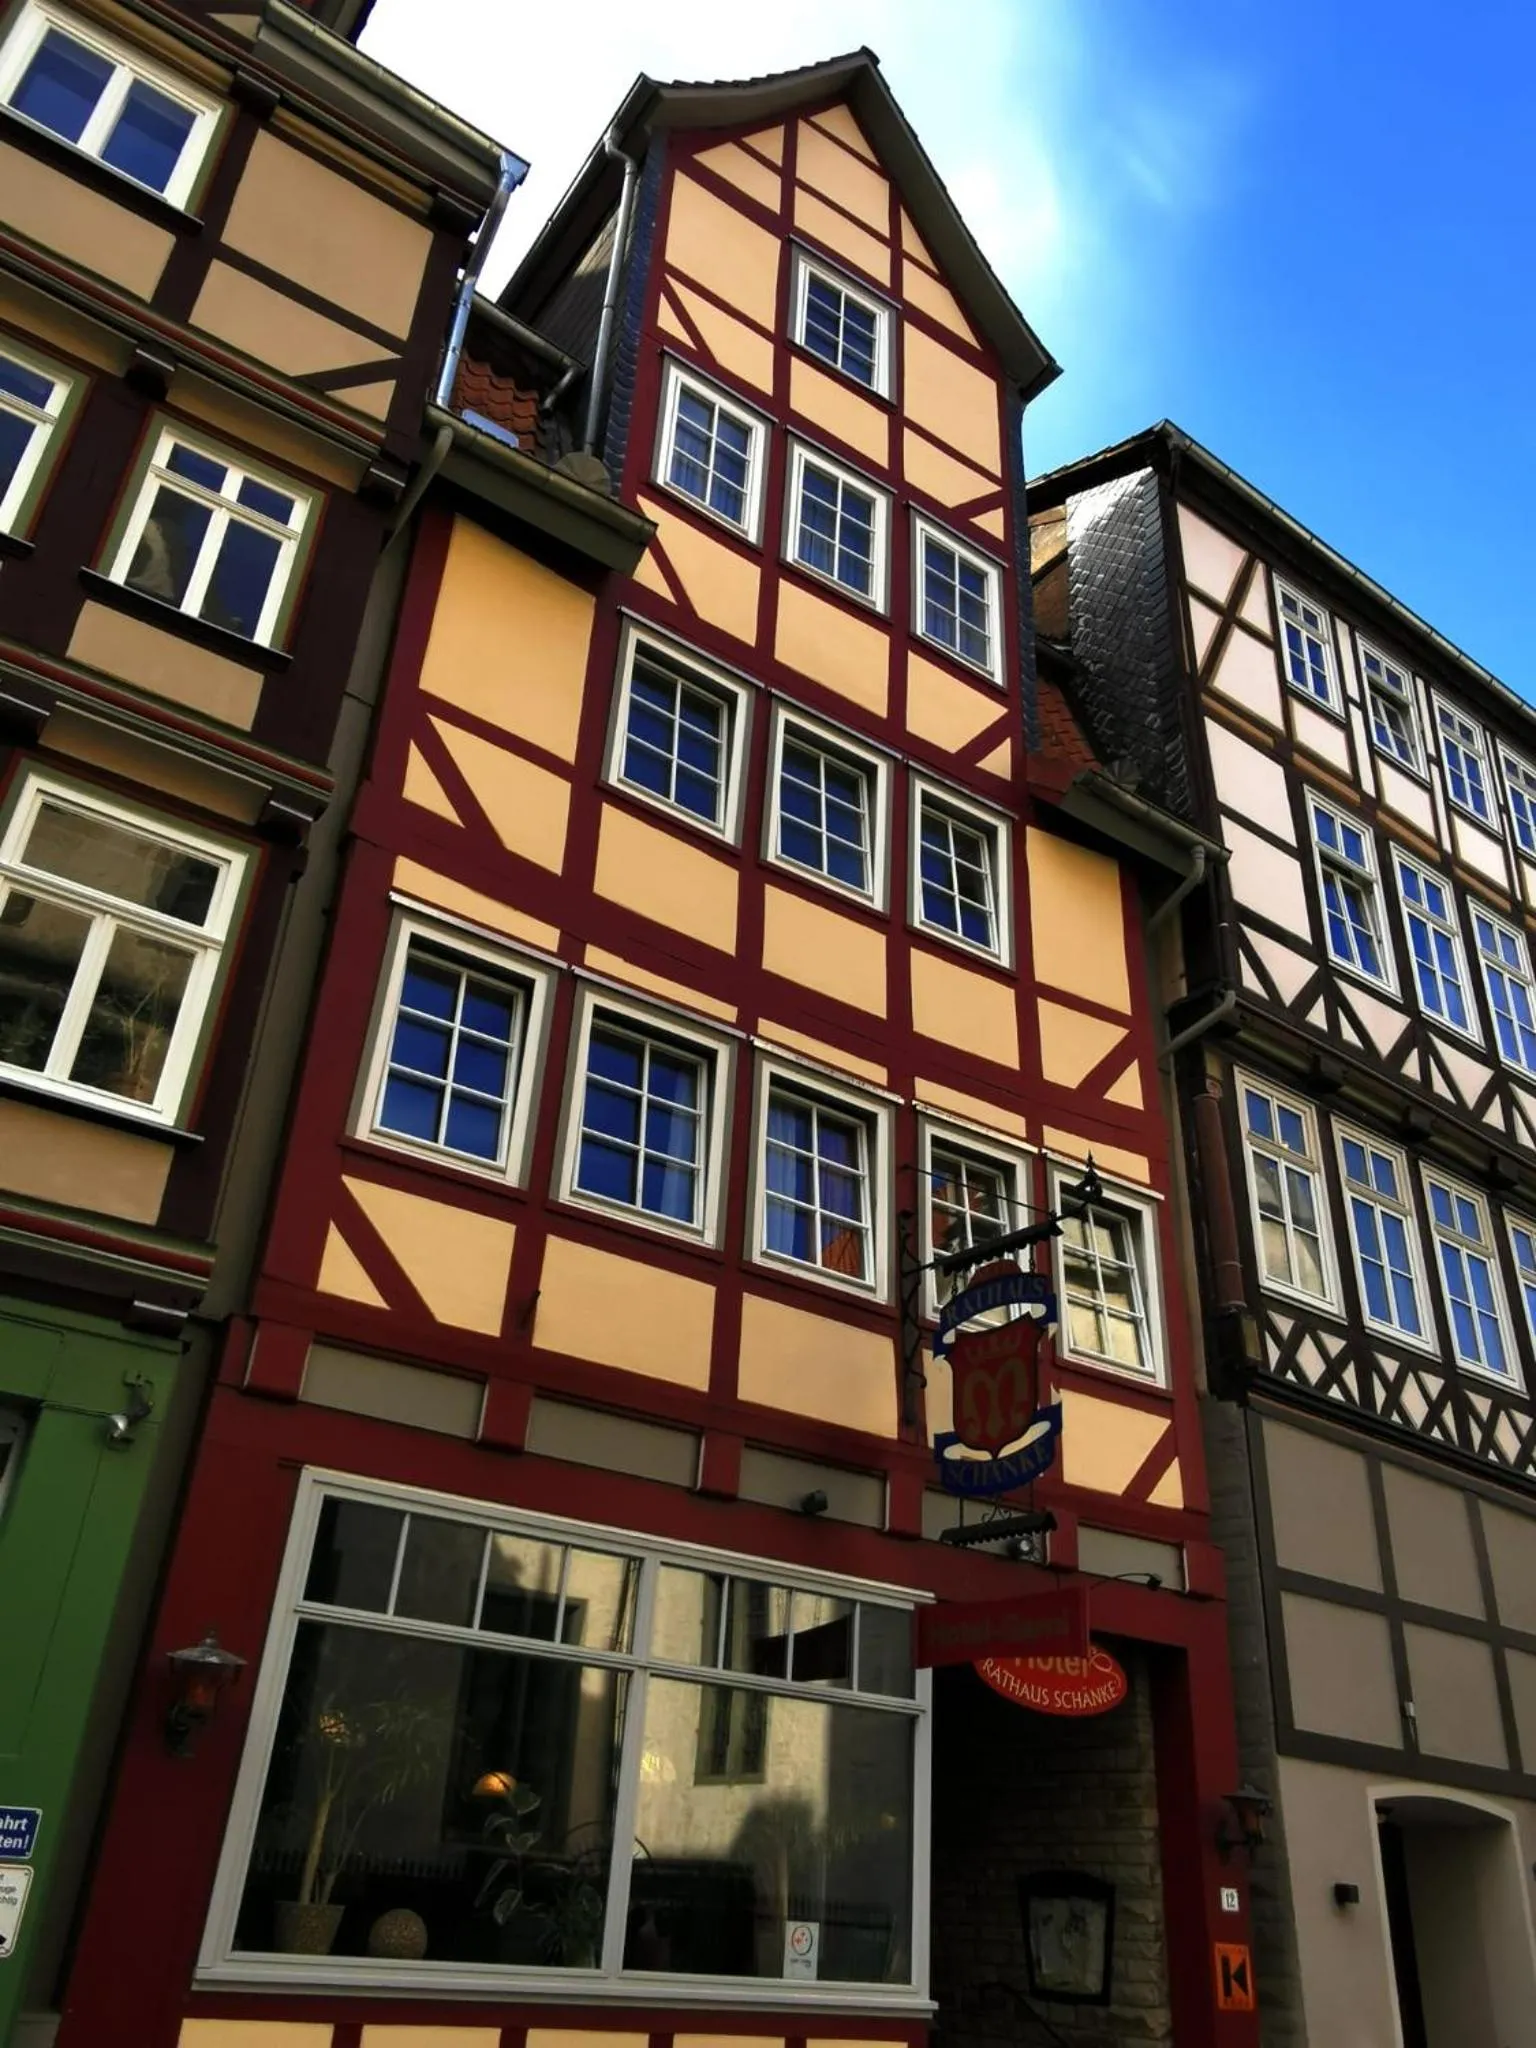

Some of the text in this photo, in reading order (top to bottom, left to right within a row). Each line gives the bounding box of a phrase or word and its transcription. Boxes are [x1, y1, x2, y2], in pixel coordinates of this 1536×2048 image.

[982, 1657, 1118, 1709] RATHAUS SCHÄNKE
[1225, 1891, 1236, 1908] 12
